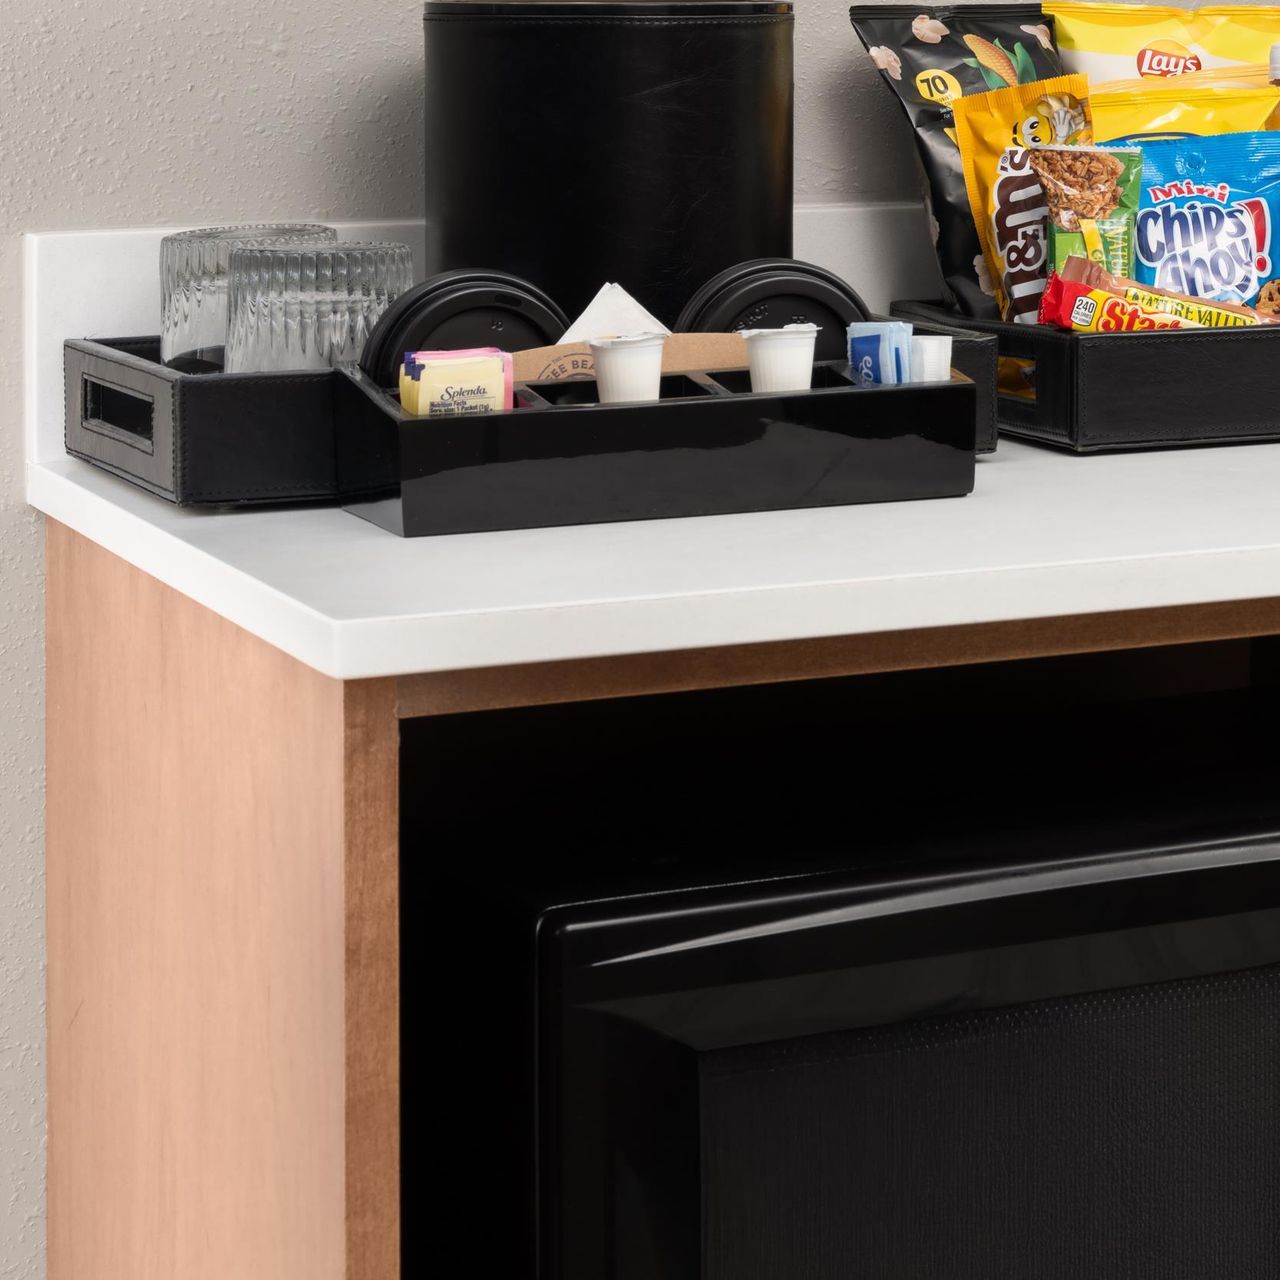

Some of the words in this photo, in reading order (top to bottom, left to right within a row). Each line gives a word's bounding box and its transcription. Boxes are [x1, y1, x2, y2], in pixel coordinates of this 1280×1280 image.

[1141, 49, 1197, 78] Lay's
[919, 74, 949, 98] 70
[1150, 181, 1228, 202] Mini
[1137, 203, 1247, 263] Chips
[1076, 299, 1095, 313] 240
[440, 386, 487, 401] Splenda
